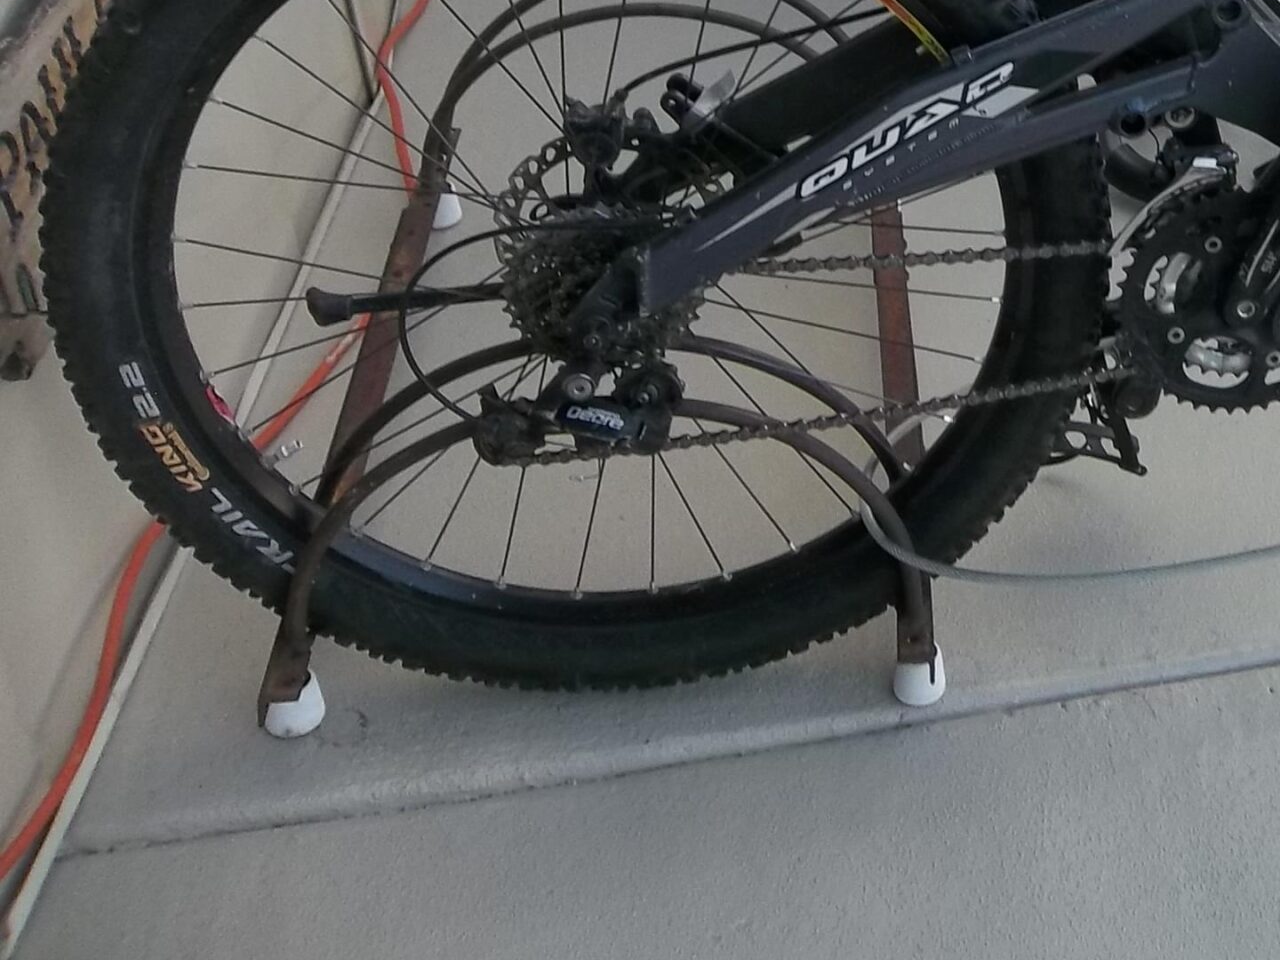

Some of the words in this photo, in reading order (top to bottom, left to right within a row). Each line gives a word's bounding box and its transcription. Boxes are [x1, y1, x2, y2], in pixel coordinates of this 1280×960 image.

[800, 61, 1015, 198] QUAD
[118, 360, 161, 419] 2.2
[140, 423, 203, 493] KING
